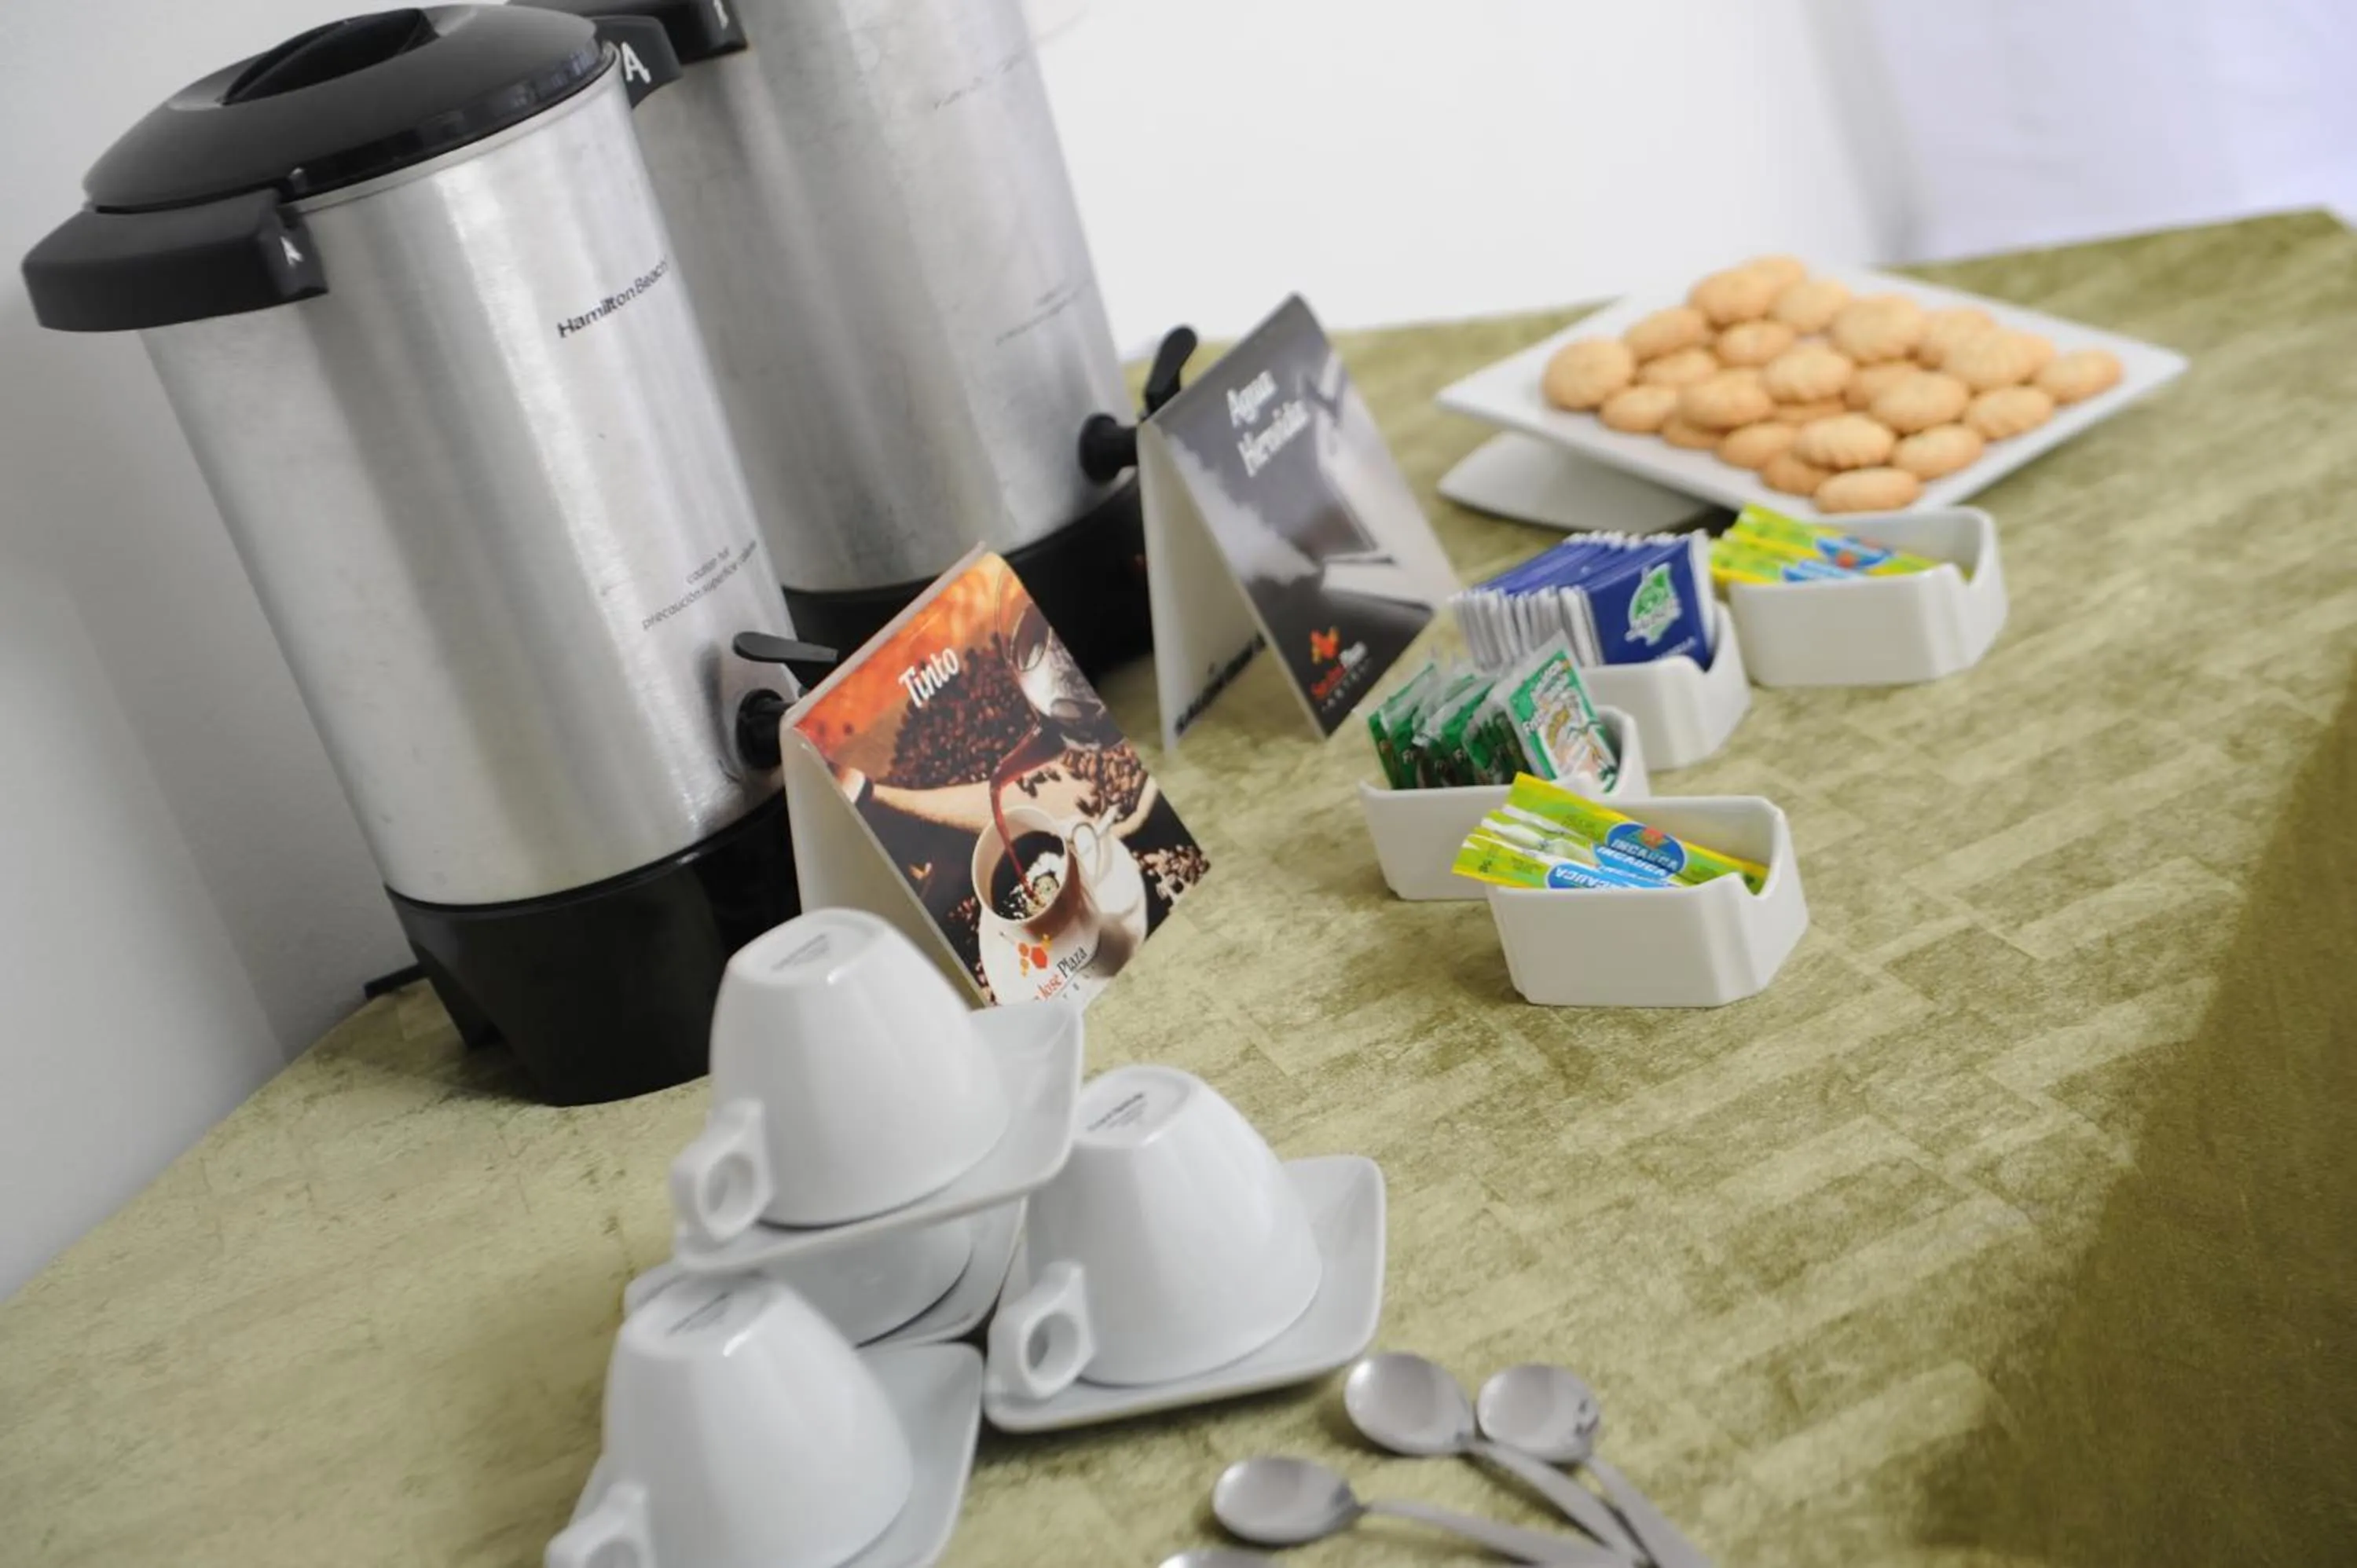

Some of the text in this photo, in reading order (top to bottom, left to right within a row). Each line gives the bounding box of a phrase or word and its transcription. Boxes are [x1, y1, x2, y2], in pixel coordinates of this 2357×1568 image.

[621, 42, 651, 83] A
[557, 288, 636, 338] Hamilton
[898, 648, 959, 708] Tinto
[1611, 838, 1678, 871] INCAUCA
[1057, 947, 1088, 979] Plaza
